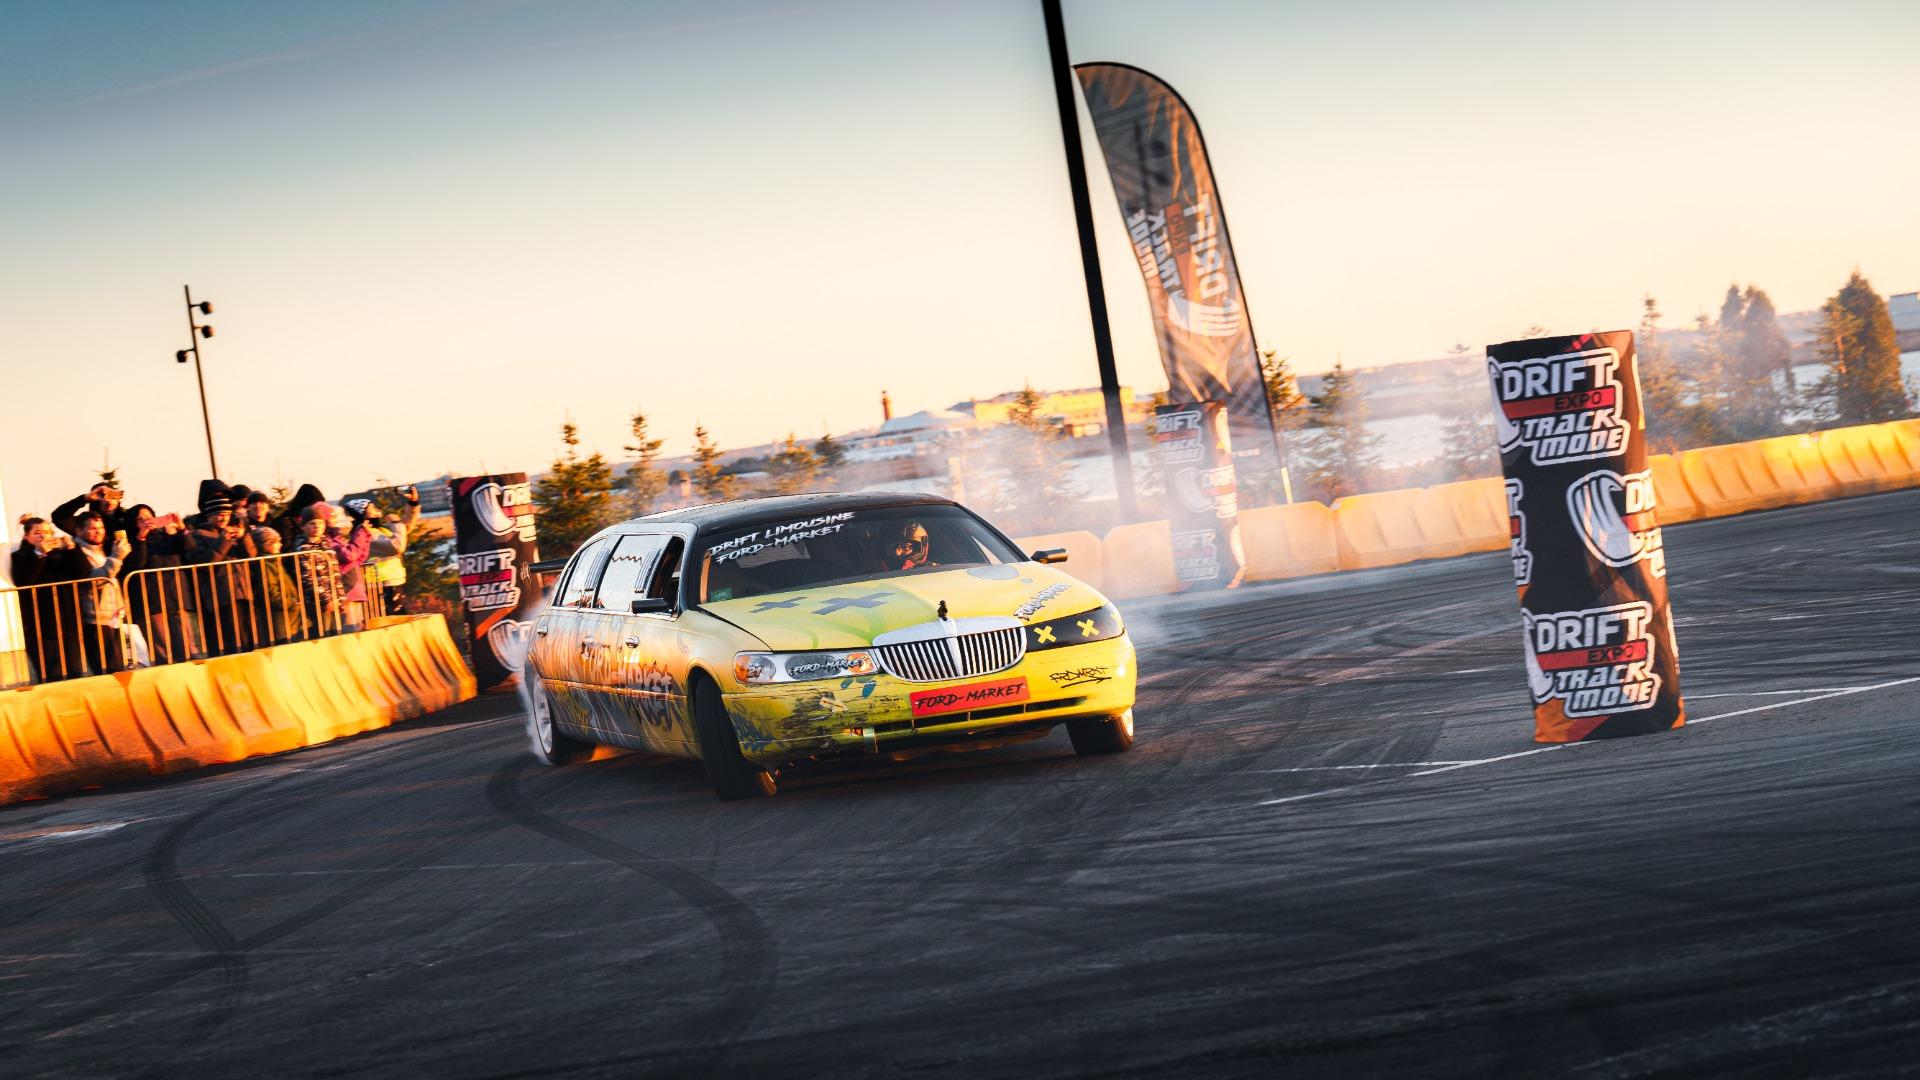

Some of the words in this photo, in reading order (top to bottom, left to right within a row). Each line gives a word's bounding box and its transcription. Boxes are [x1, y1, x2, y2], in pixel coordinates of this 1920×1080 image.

[1503, 355, 1612, 400] DRIFT
[1554, 391, 1602, 411] EXPO
[710, 531, 761, 556] DRIFT
[764, 511, 856, 539] LIMOUSINE
[715, 523, 844, 565] FORD-MARKET
[1537, 609, 1645, 652] DRIFT
[1587, 646, 1633, 664] EXPO
